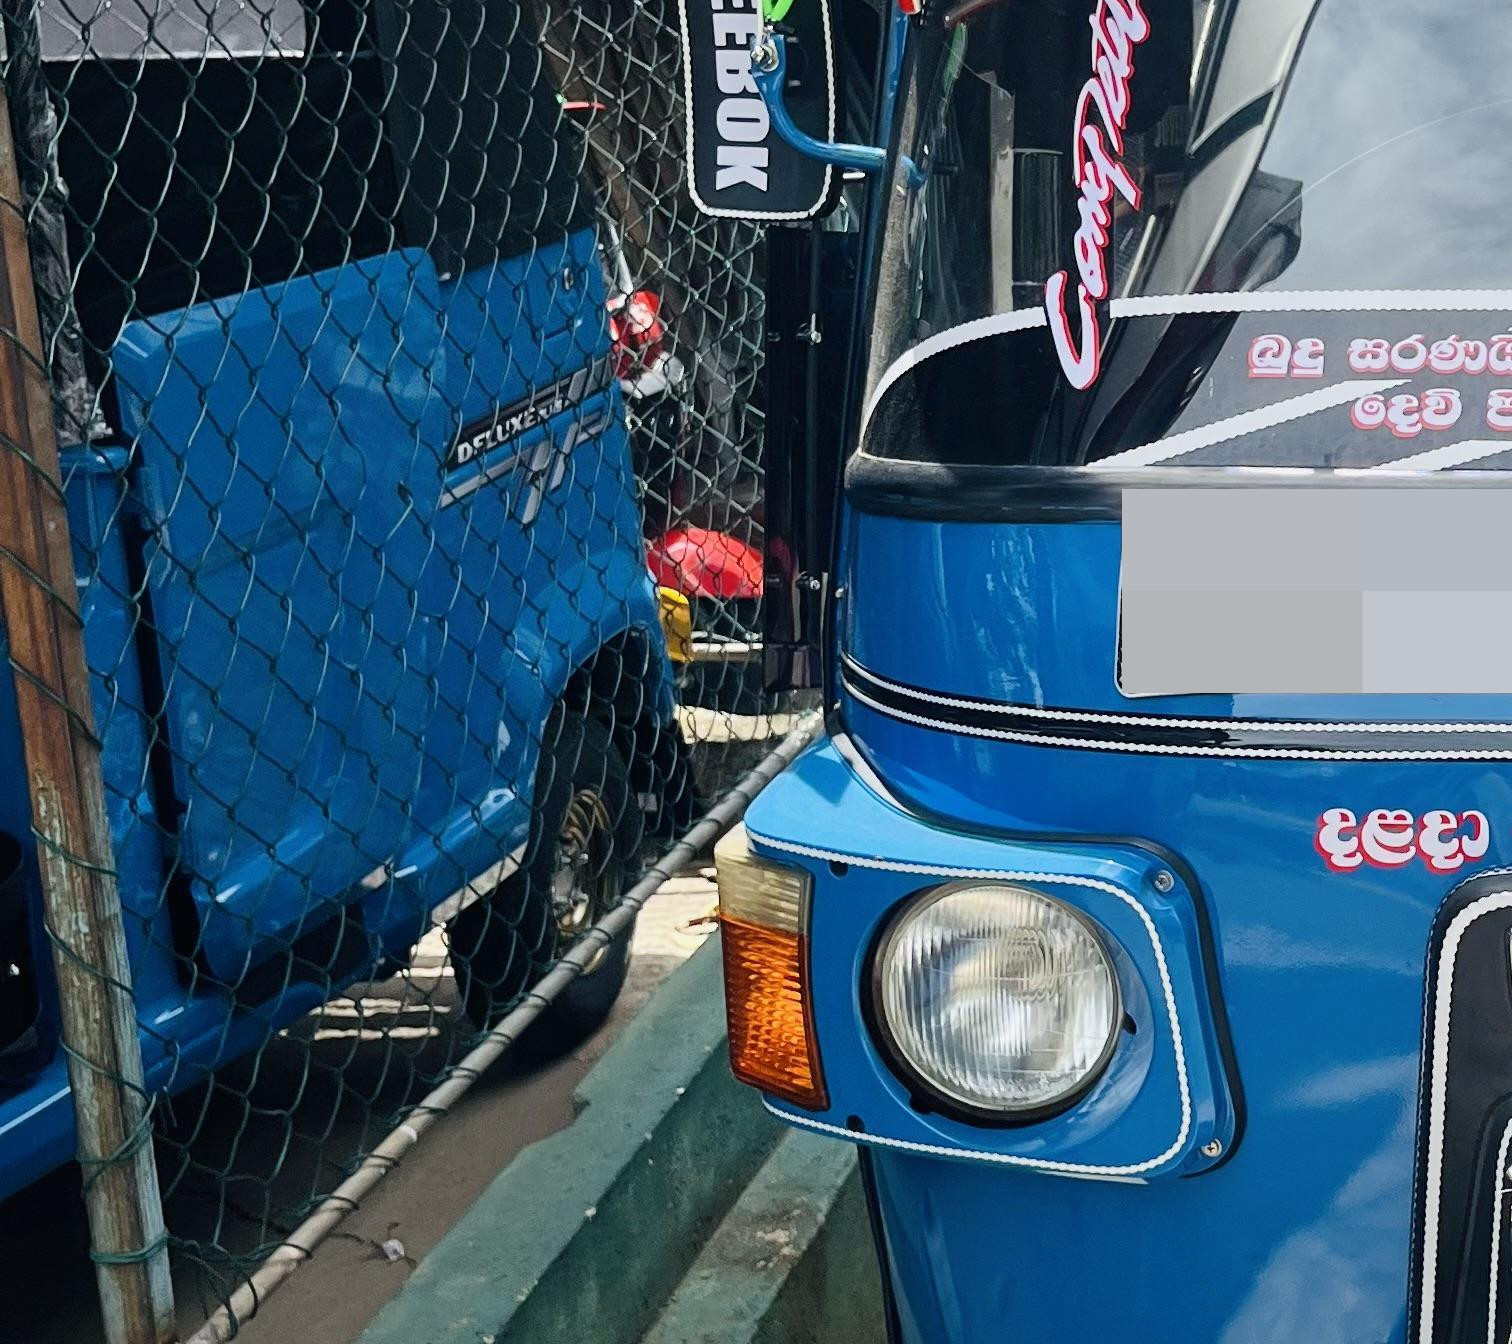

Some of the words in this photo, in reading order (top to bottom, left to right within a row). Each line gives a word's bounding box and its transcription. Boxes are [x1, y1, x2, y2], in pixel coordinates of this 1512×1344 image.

[1248, 334, 1325, 378] බුදු
[1350, 388, 1463, 439] දෙවි
[1314, 807, 1490, 875] දළදා
